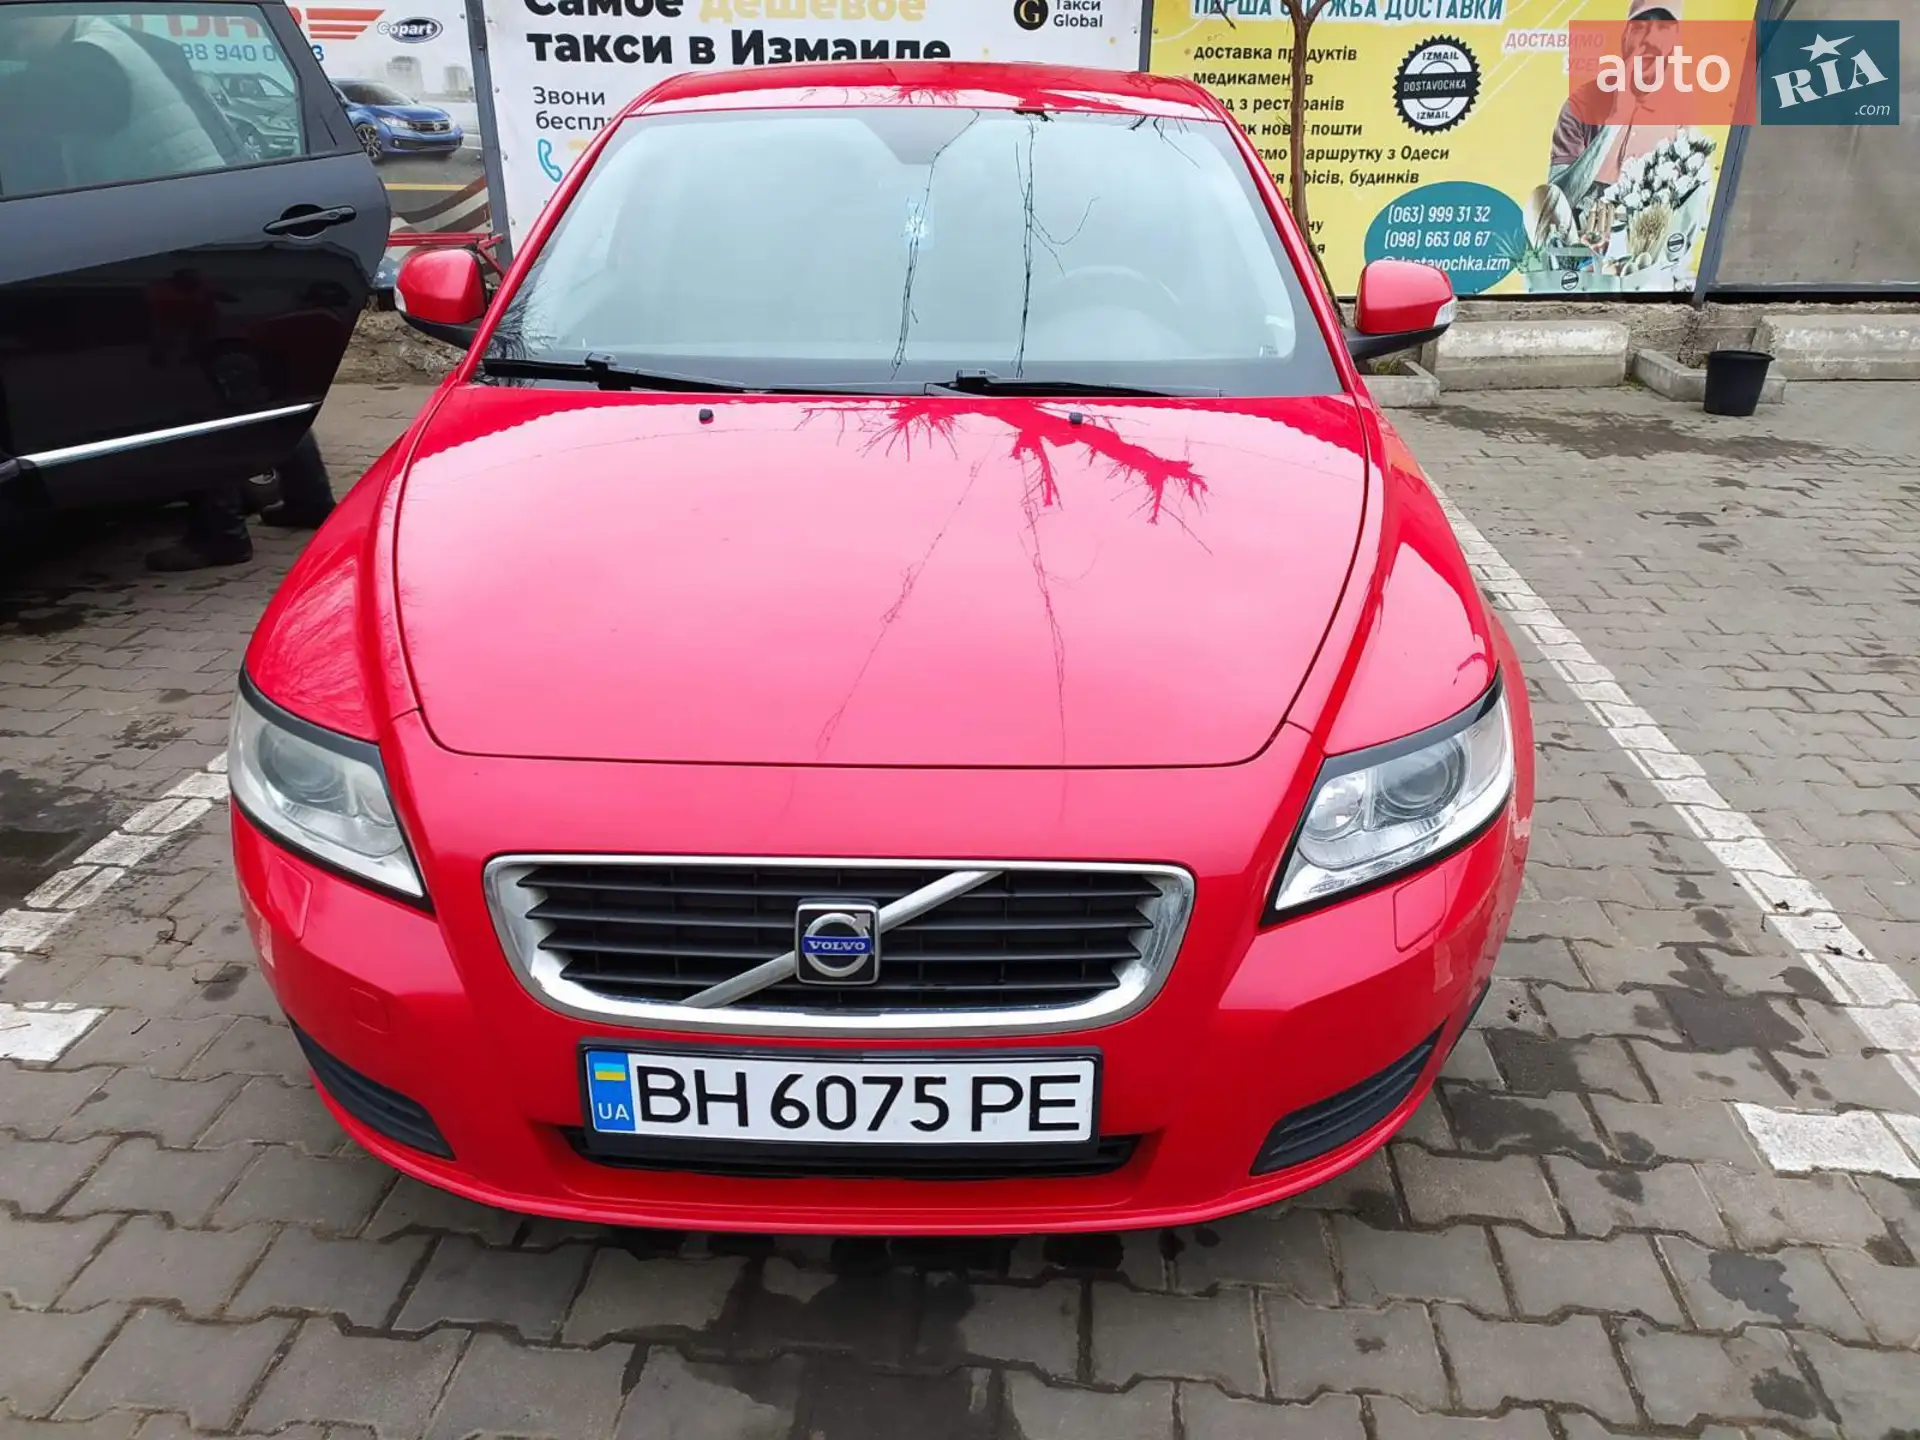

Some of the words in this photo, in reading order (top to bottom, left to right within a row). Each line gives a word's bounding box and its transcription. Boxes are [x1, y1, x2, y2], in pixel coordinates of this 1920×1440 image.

[523, 0, 684, 18] Самое
[699, 0, 927, 23] дешевое
[1055, 0, 1101, 11] Такси
[1384, 0, 1501, 20] ДОСТАВКИ
[377, 21, 434, 38] Copart
[1053, 14, 1103, 28] Global
[215, 44, 257, 61] 940
[526, 33, 673, 64] такси
[689, 36, 716, 64] в
[1193, 47, 1272, 59] доставка
[1278, 45, 1357, 63] прдуктів
[1422, 51, 1459, 60] IZMAIL
[1193, 72, 1314, 86] медикаменв
[1403, 79, 1467, 92] DOSTAVOCHKA
[533, 86, 605, 105] Звони
[1239, 98, 1248, 110] з
[1253, 96, 1344, 113] рестранів
[535, 110, 611, 130] беспл
[1416, 111, 1450, 120] IZMAIL
[1311, 124, 1363, 136] пошти
[1305, 148, 1383, 163] аршрутку
[1387, 149, 1396, 160] з
[1400, 145, 1450, 161] Одеси
[1349, 168, 1420, 187] будинків
[1387, 204, 1425, 225] (063)
[1428, 206, 1454, 223] 999
[1456, 206, 1470, 223] 31
[1474, 206, 1492, 222] 32
[1384, 229, 1422, 249] (098)
[1425, 231, 1450, 247] 663
[1453, 231, 1471, 247] 08
[1474, 231, 1491, 247] 67
[807, 940, 866, 950] VOLVO
[636, 1065, 749, 1127] BH
[770, 1073, 950, 1132] 6075
[970, 1074, 1081, 1132] PE
[598, 1102, 630, 1121] UA
